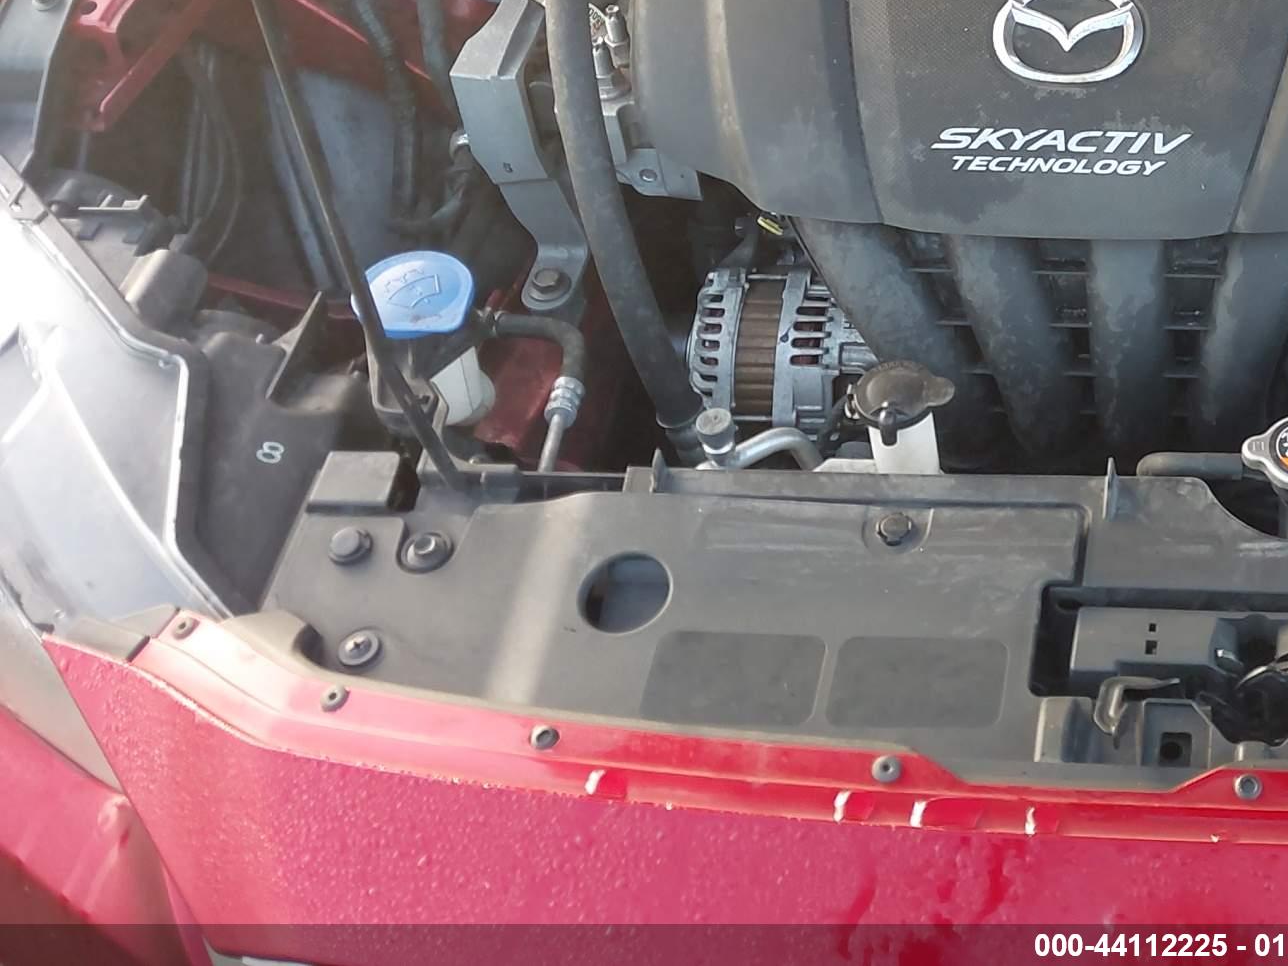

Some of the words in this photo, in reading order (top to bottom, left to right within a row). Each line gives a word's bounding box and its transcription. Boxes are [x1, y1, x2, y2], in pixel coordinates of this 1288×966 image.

[930, 127, 1192, 155] SKYACTIV
[951, 155, 1167, 176] TECHNOLOGY
[256, 441, 285, 464] 8
